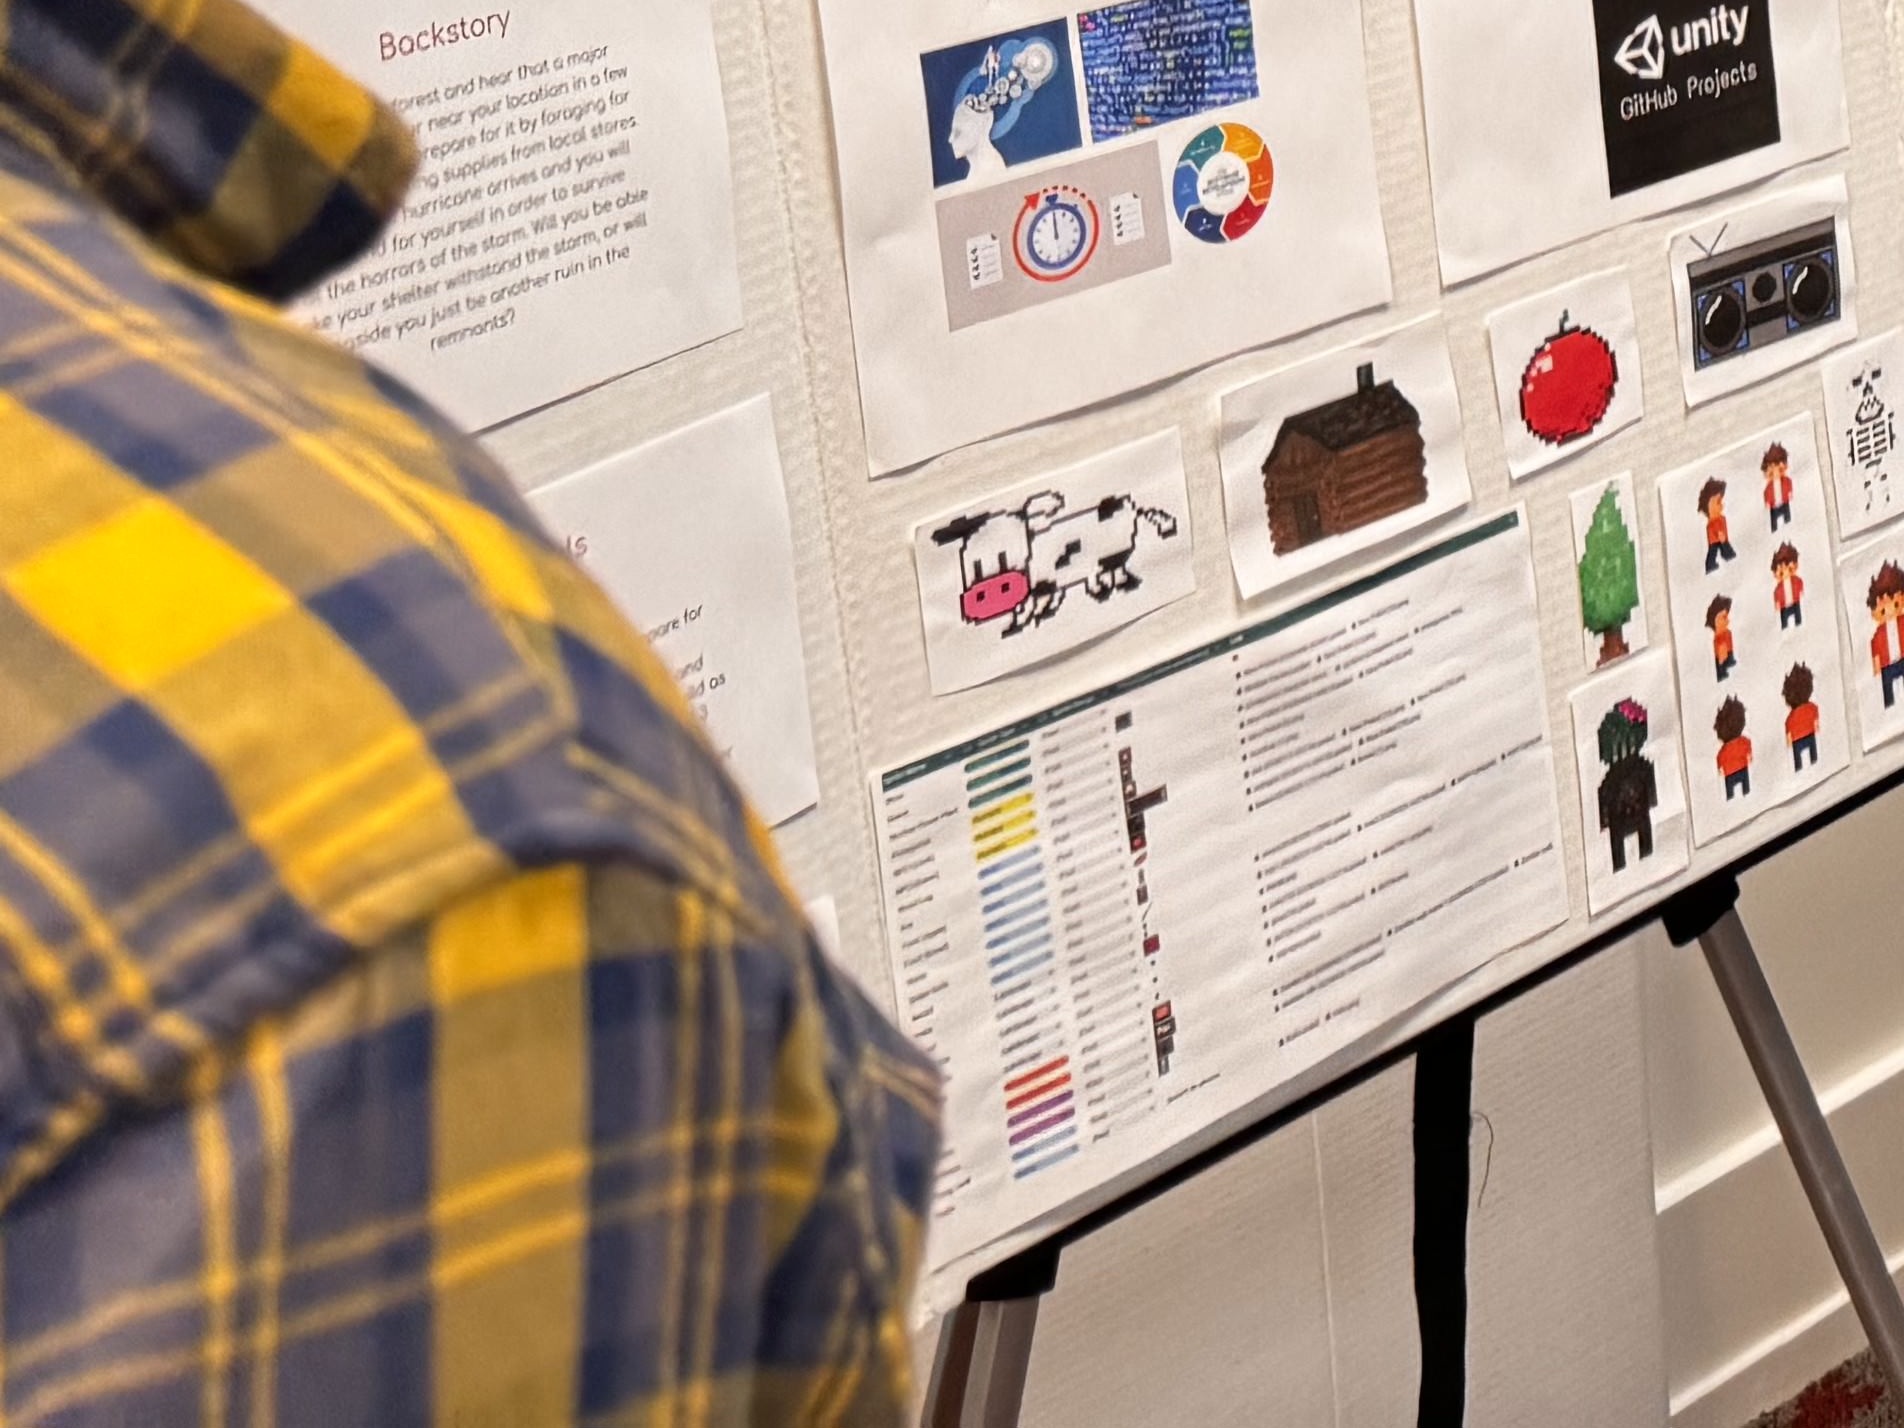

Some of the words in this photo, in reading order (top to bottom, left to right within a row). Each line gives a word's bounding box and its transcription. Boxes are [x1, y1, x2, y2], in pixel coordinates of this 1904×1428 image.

[378, 9, 511, 62] Backstory
[1669, 3, 1749, 56] unity
[426, 109, 466, 133] near
[467, 98, 503, 126] your
[504, 80, 570, 111] location
[571, 74, 588, 92] in
[602, 65, 628, 84] few
[442, 76, 476, 101] and
[477, 68, 514, 91] hear
[516, 58, 551, 81] that
[565, 44, 609, 68] major
[1619, 83, 1678, 121] GitHub
[1686, 59, 1758, 100] Projects
[419, 133, 477, 162] repare
[478, 124, 502, 144] for
[504, 119, 517, 139] it
[517, 115, 539, 136] by
[539, 95, 607, 128] foraging
[607, 88, 630, 107] for
[441, 150, 509, 185] supplies
[509, 139, 547, 164] from
[547, 124, 588, 152] local
[429, 305, 516, 352] remnants?
